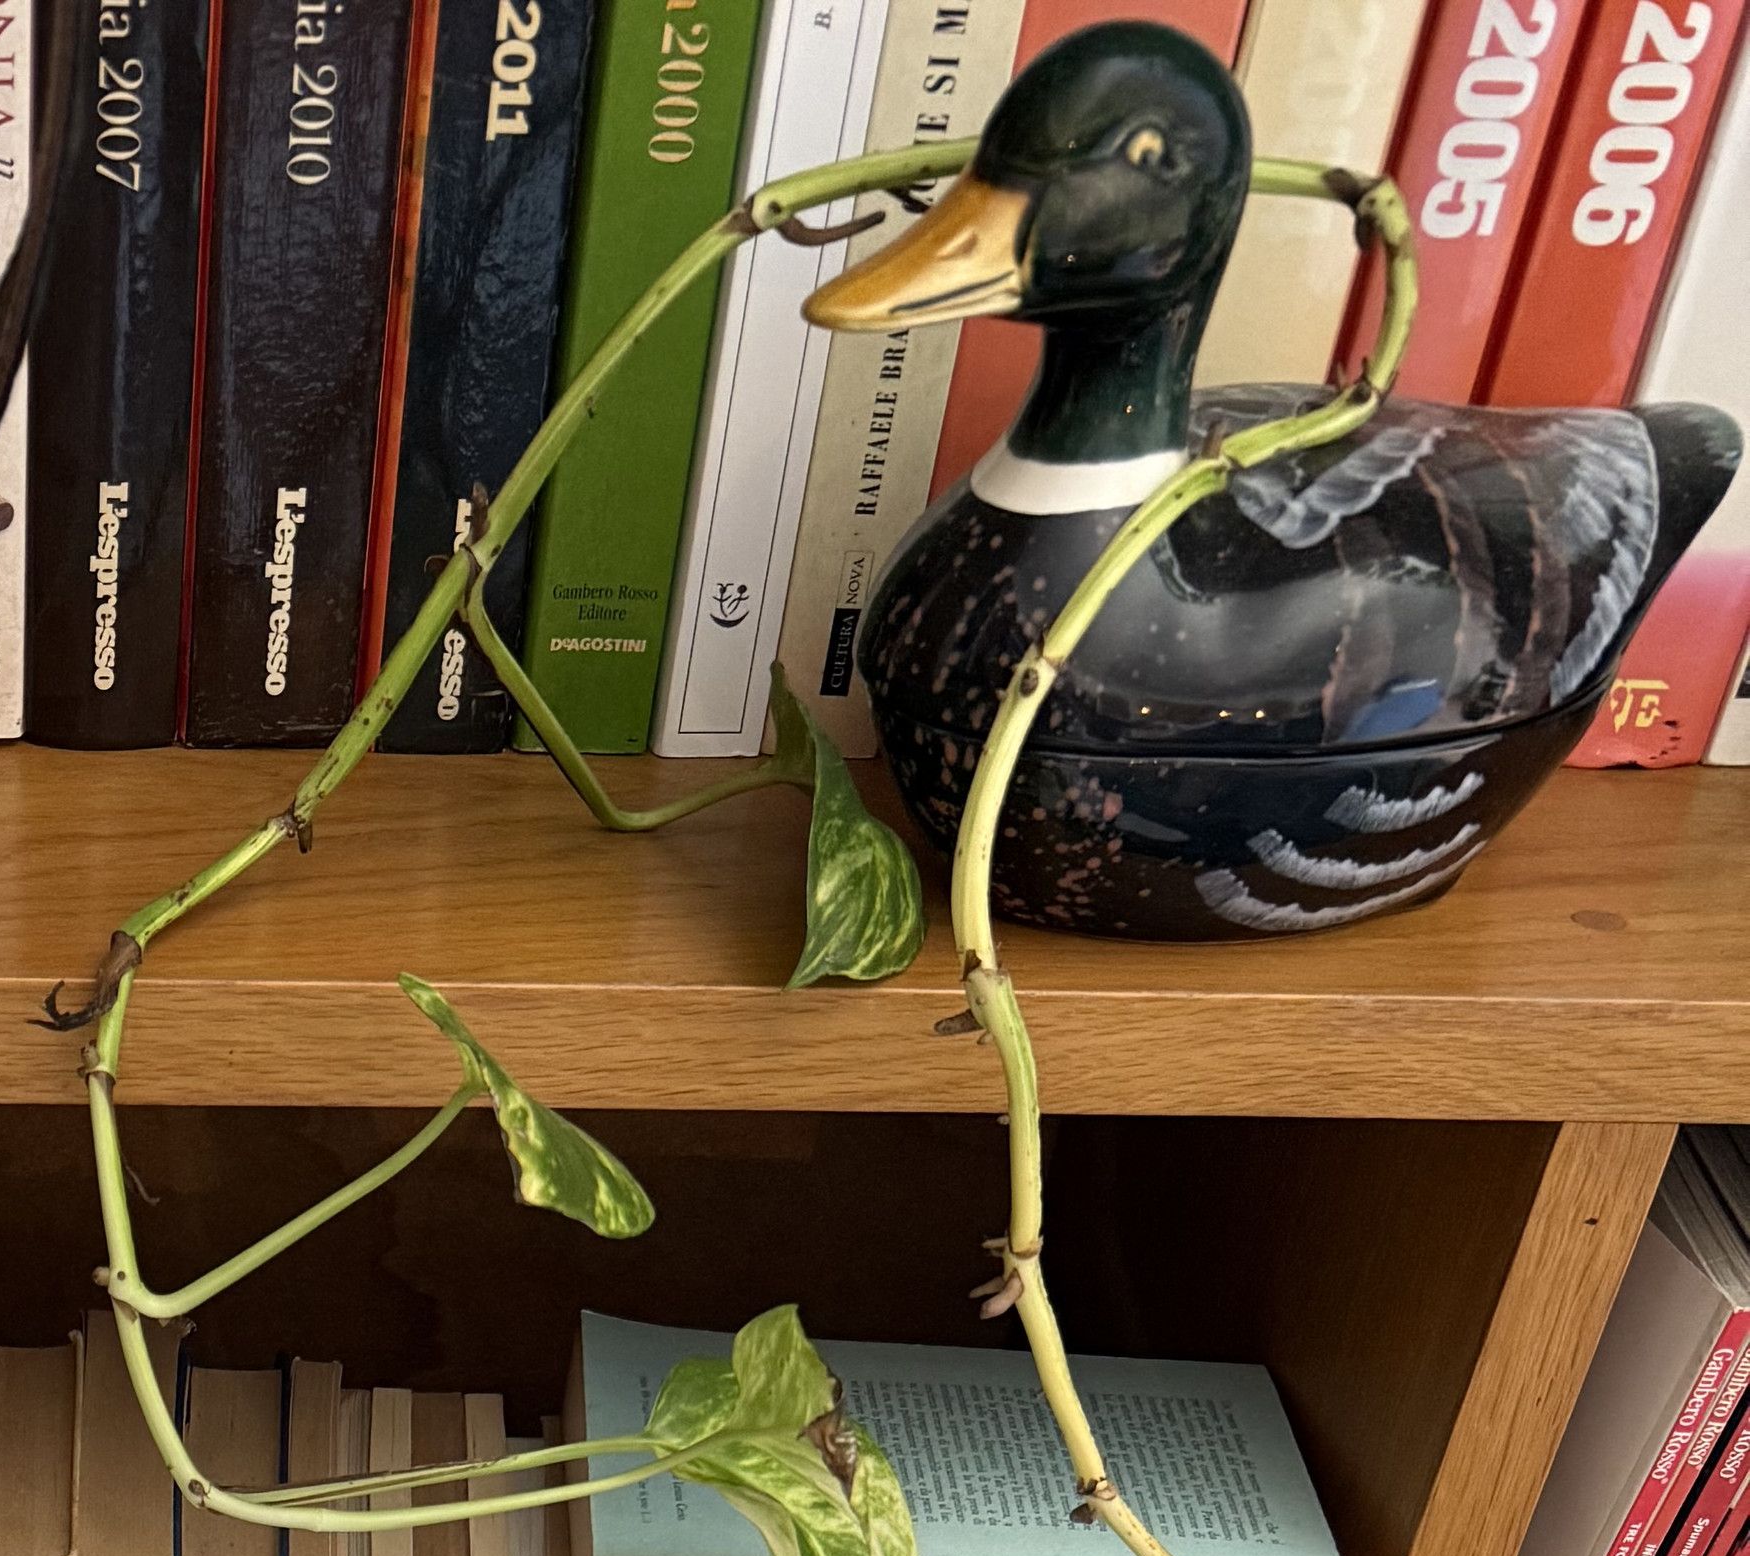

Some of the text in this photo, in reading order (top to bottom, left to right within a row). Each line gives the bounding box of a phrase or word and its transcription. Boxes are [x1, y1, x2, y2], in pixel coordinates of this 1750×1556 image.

[95, 57, 144, 192] 2007
[286, 63, 339, 186] 2010
[485, 0, 542, 142] 2011
[646, 22, 711, 165] 2000
[922, 55, 959, 95] SI
[1420, 0, 1556, 240] 2005
[1572, 0, 1713, 248] 2006
[854, 391, 899, 517] RAFFAELE
[90, 481, 128, 691] L'espresso
[264, 487, 307, 696] L'espresso
[553, 583, 658, 602] Gambero Rosso
[577, 603, 627, 621] Editore
[827, 555, 867, 689] CULTURA NOVA
[1680, 1348, 1734, 1434] Gambero
[1622, 1522, 1642, 1543] TRE
